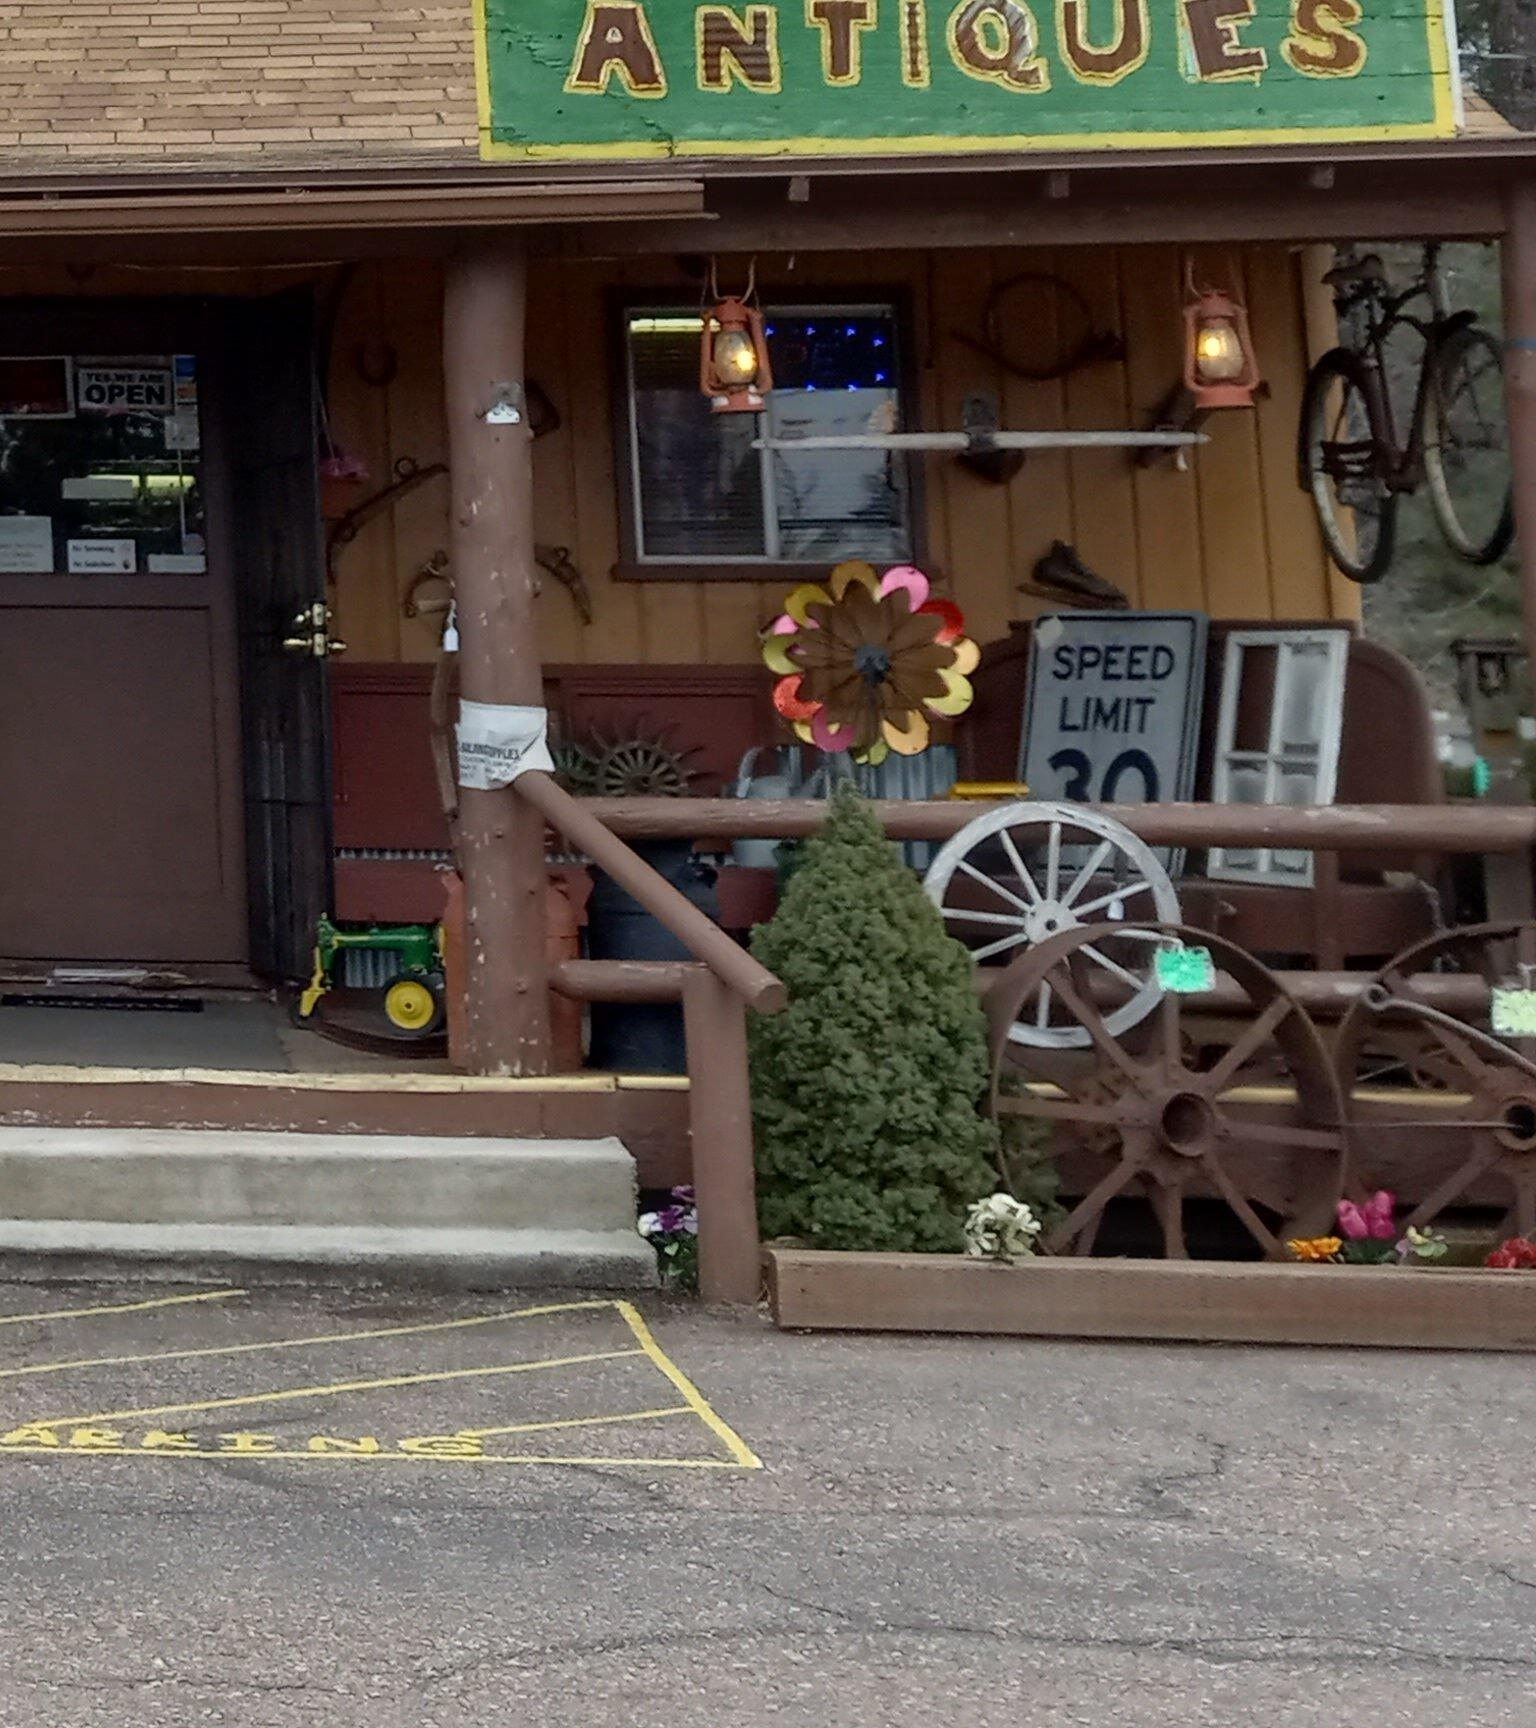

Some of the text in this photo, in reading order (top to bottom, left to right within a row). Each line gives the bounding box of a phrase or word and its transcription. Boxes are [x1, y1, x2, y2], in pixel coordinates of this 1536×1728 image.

[84, 384, 166, 405] OPEN
[1052, 644, 1175, 681] SPEED
[1059, 696, 1156, 734] LIMIT
[1047, 748, 1161, 803] 30
